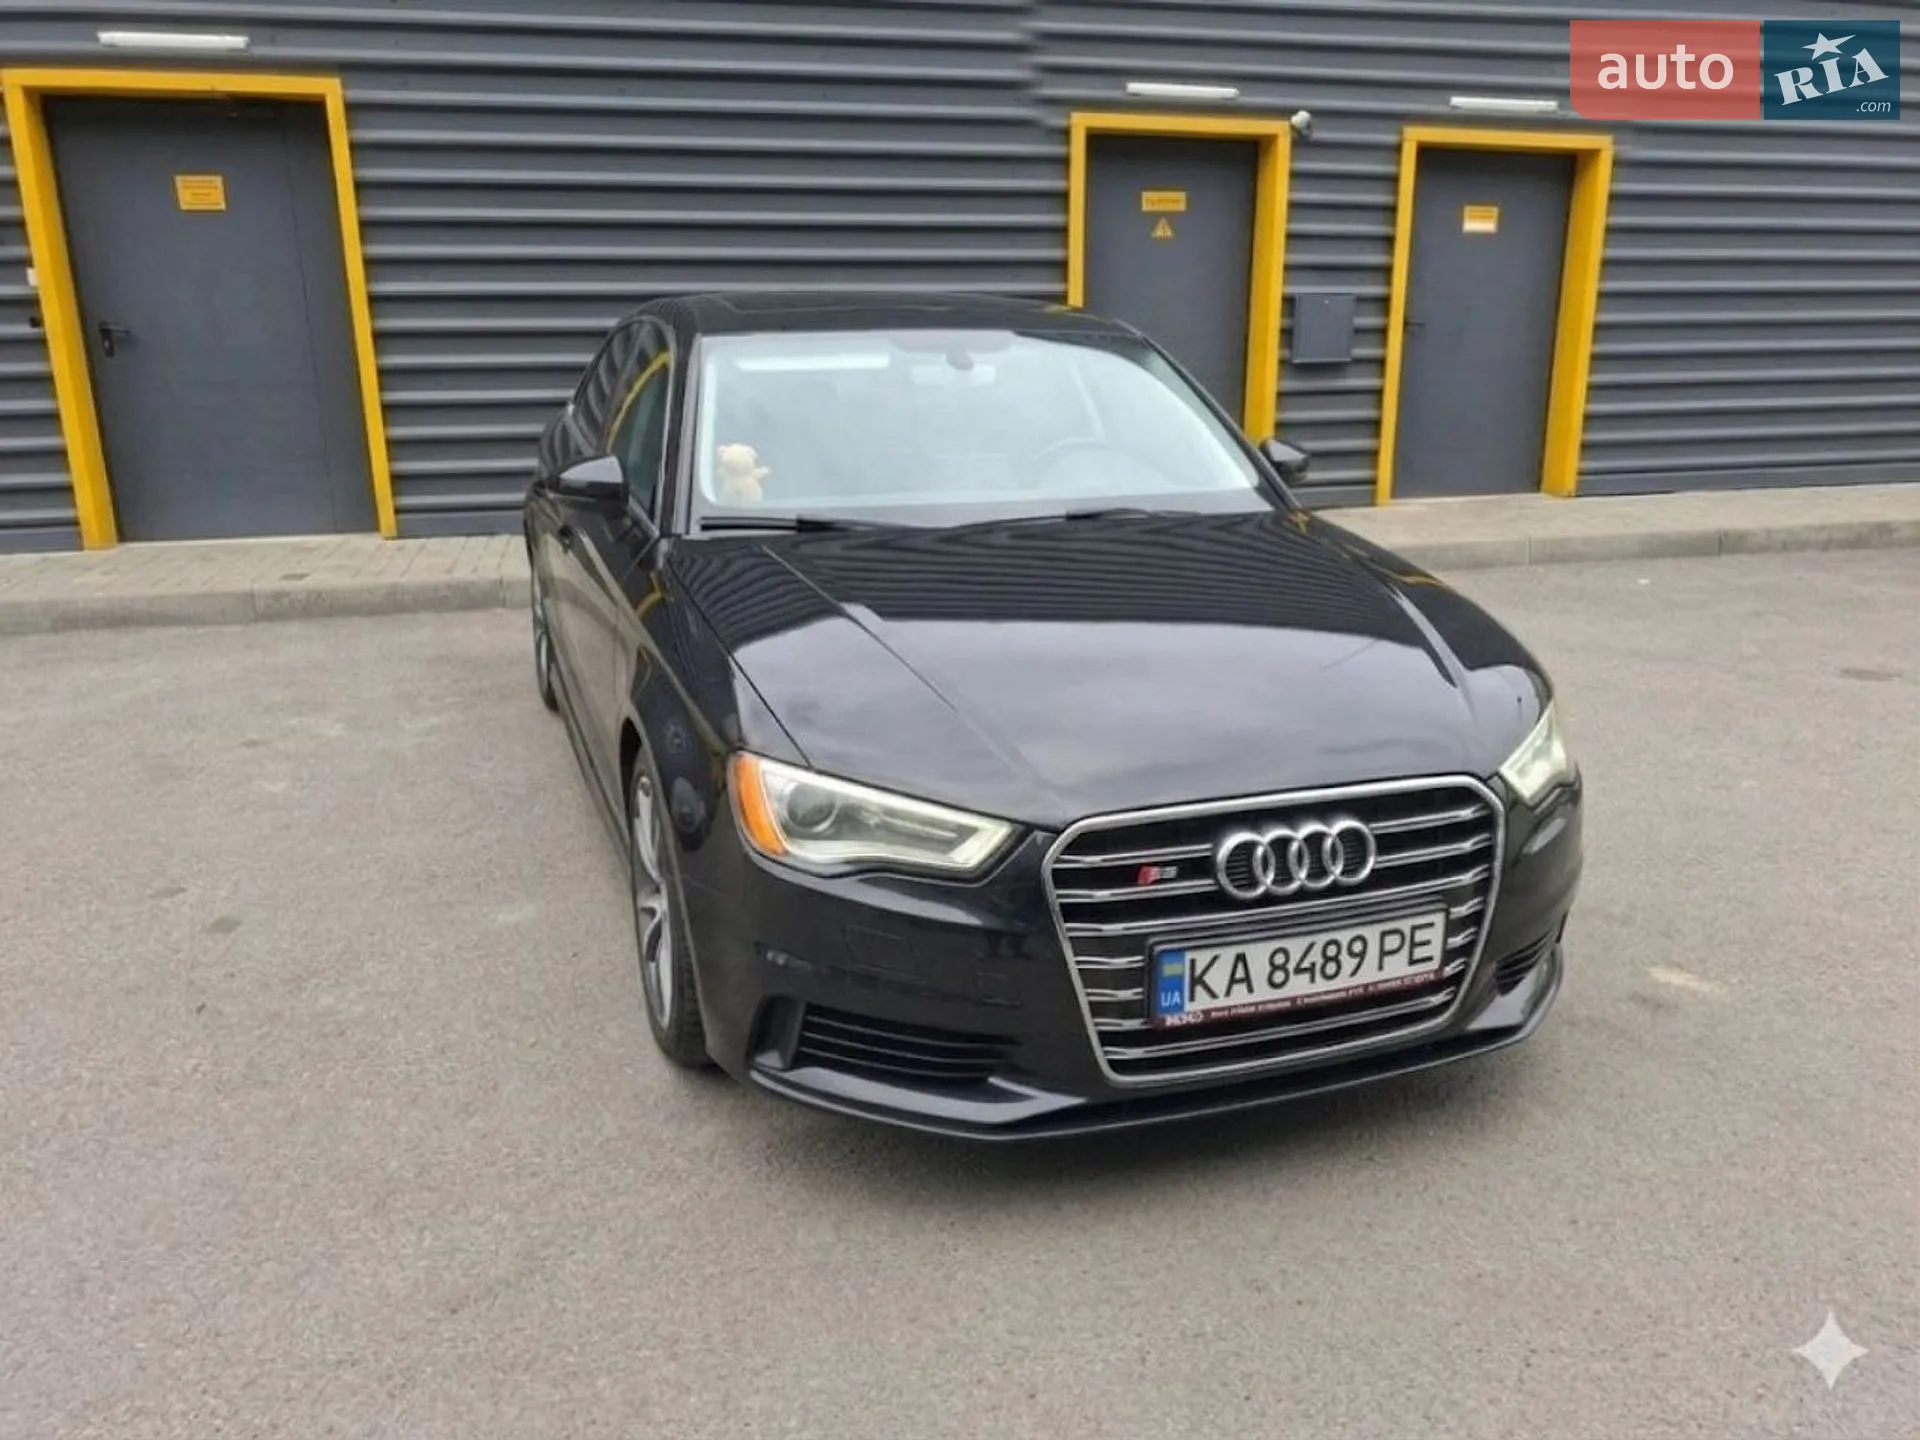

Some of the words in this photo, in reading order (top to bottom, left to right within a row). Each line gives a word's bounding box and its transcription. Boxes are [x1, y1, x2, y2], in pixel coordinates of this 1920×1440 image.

[1188, 953, 1254, 1002] KA
[1267, 934, 1369, 990] 8489
[1378, 922, 1436, 972] PE
[1160, 992, 1182, 1007] UA
